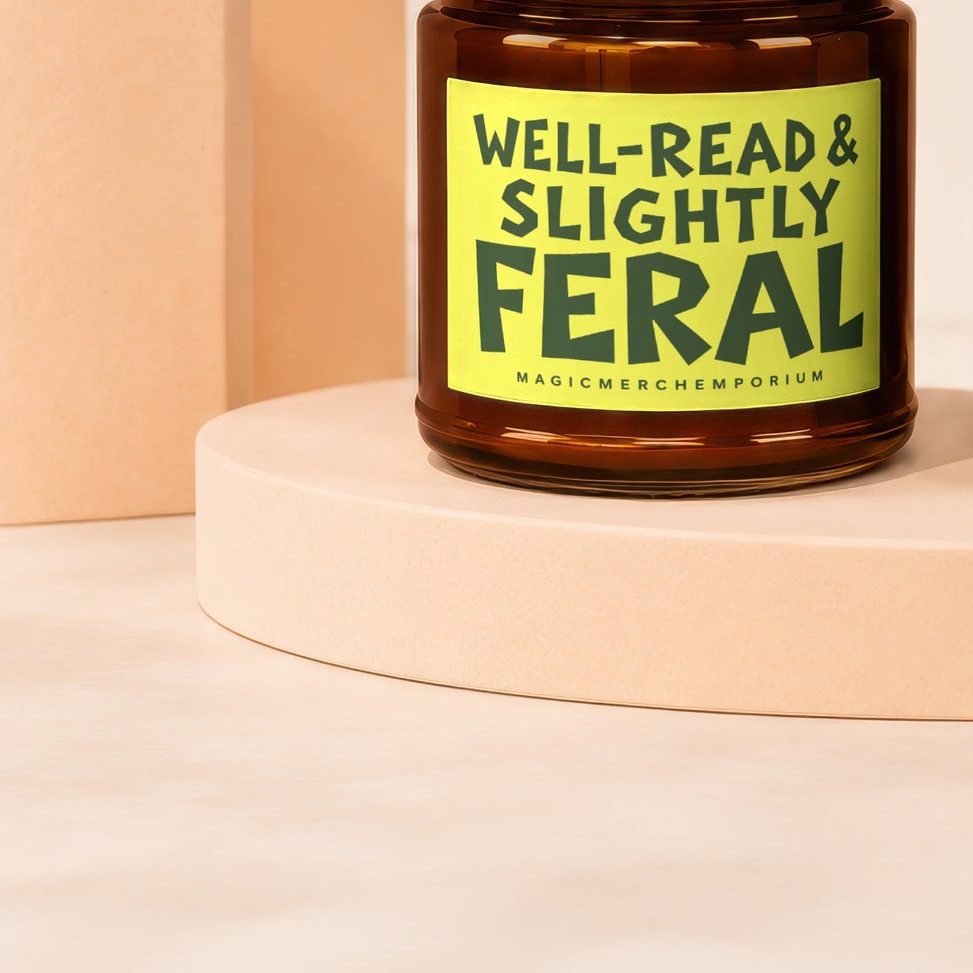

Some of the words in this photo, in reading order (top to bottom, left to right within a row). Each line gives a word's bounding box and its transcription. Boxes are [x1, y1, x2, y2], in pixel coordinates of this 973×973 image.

[473, 113, 816, 179] WELL-READ
[826, 113, 860, 168] &
[500, 178, 841, 245] SLIGHTLY
[475, 239, 864, 366] FERAL
[516, 369, 825, 391] MAGICMERCHEMPORIUM
